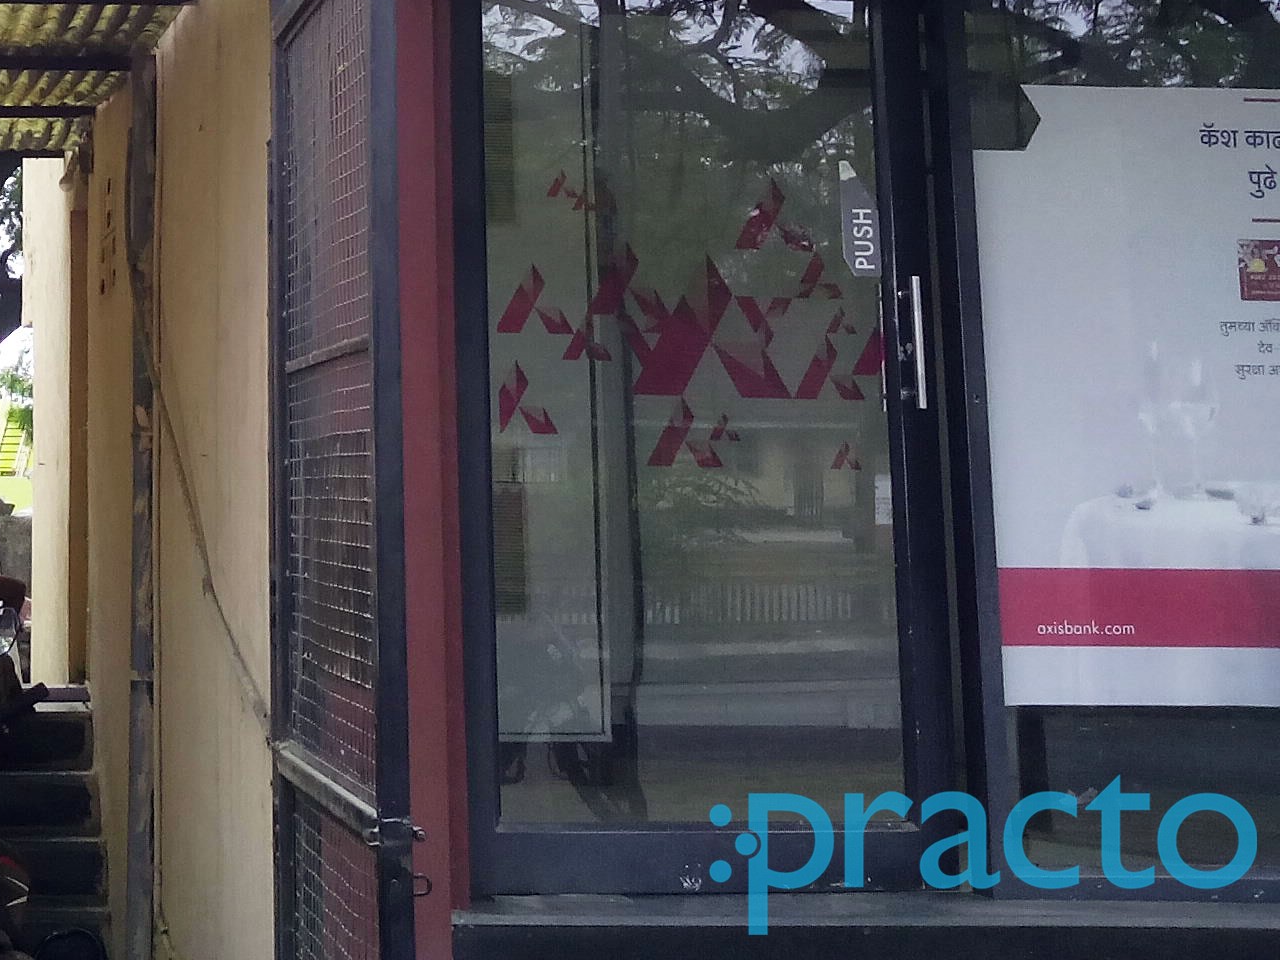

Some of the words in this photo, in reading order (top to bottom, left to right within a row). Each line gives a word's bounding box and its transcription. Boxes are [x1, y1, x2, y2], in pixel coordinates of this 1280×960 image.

[1199, 122, 1239, 148] कॅश
[1248, 163, 1278, 198] पुढे
[851, 208, 875, 271] PUSH
[1037, 619, 1135, 636] axisbank.com
